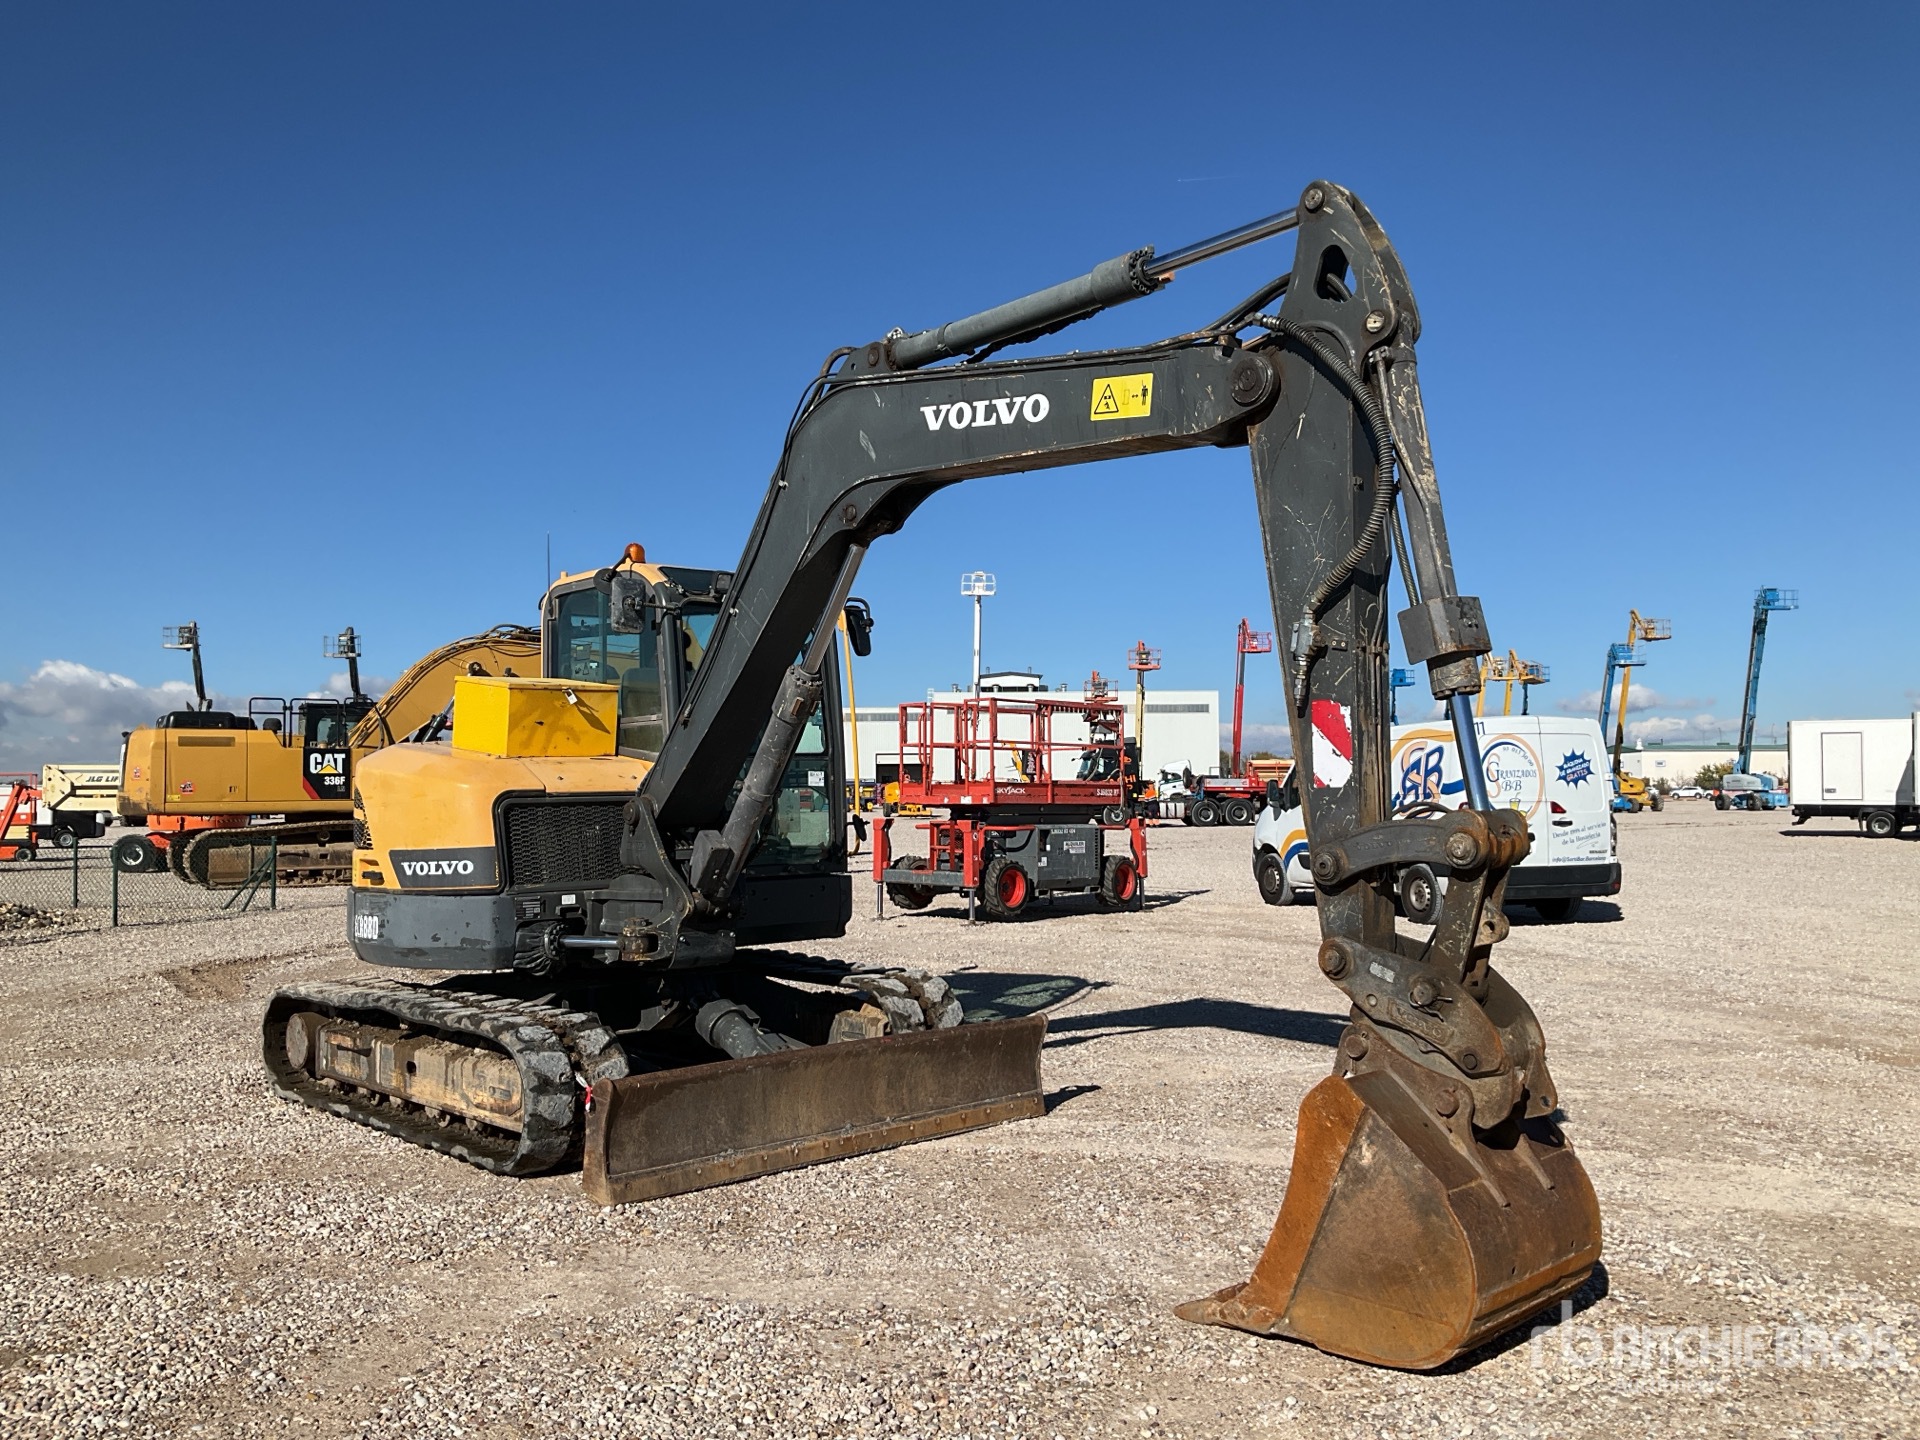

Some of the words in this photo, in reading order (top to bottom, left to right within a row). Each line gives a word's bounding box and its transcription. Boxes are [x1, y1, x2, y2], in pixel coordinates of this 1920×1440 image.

[920, 393, 1050, 431] VOLVO
[309, 752, 346, 774] CAT
[323, 775, 346, 786] 336F
[1566, 768, 1588, 782] GRATIS
[995, 786, 1026, 795] SKYJACK
[401, 859, 474, 876] VOLVO
